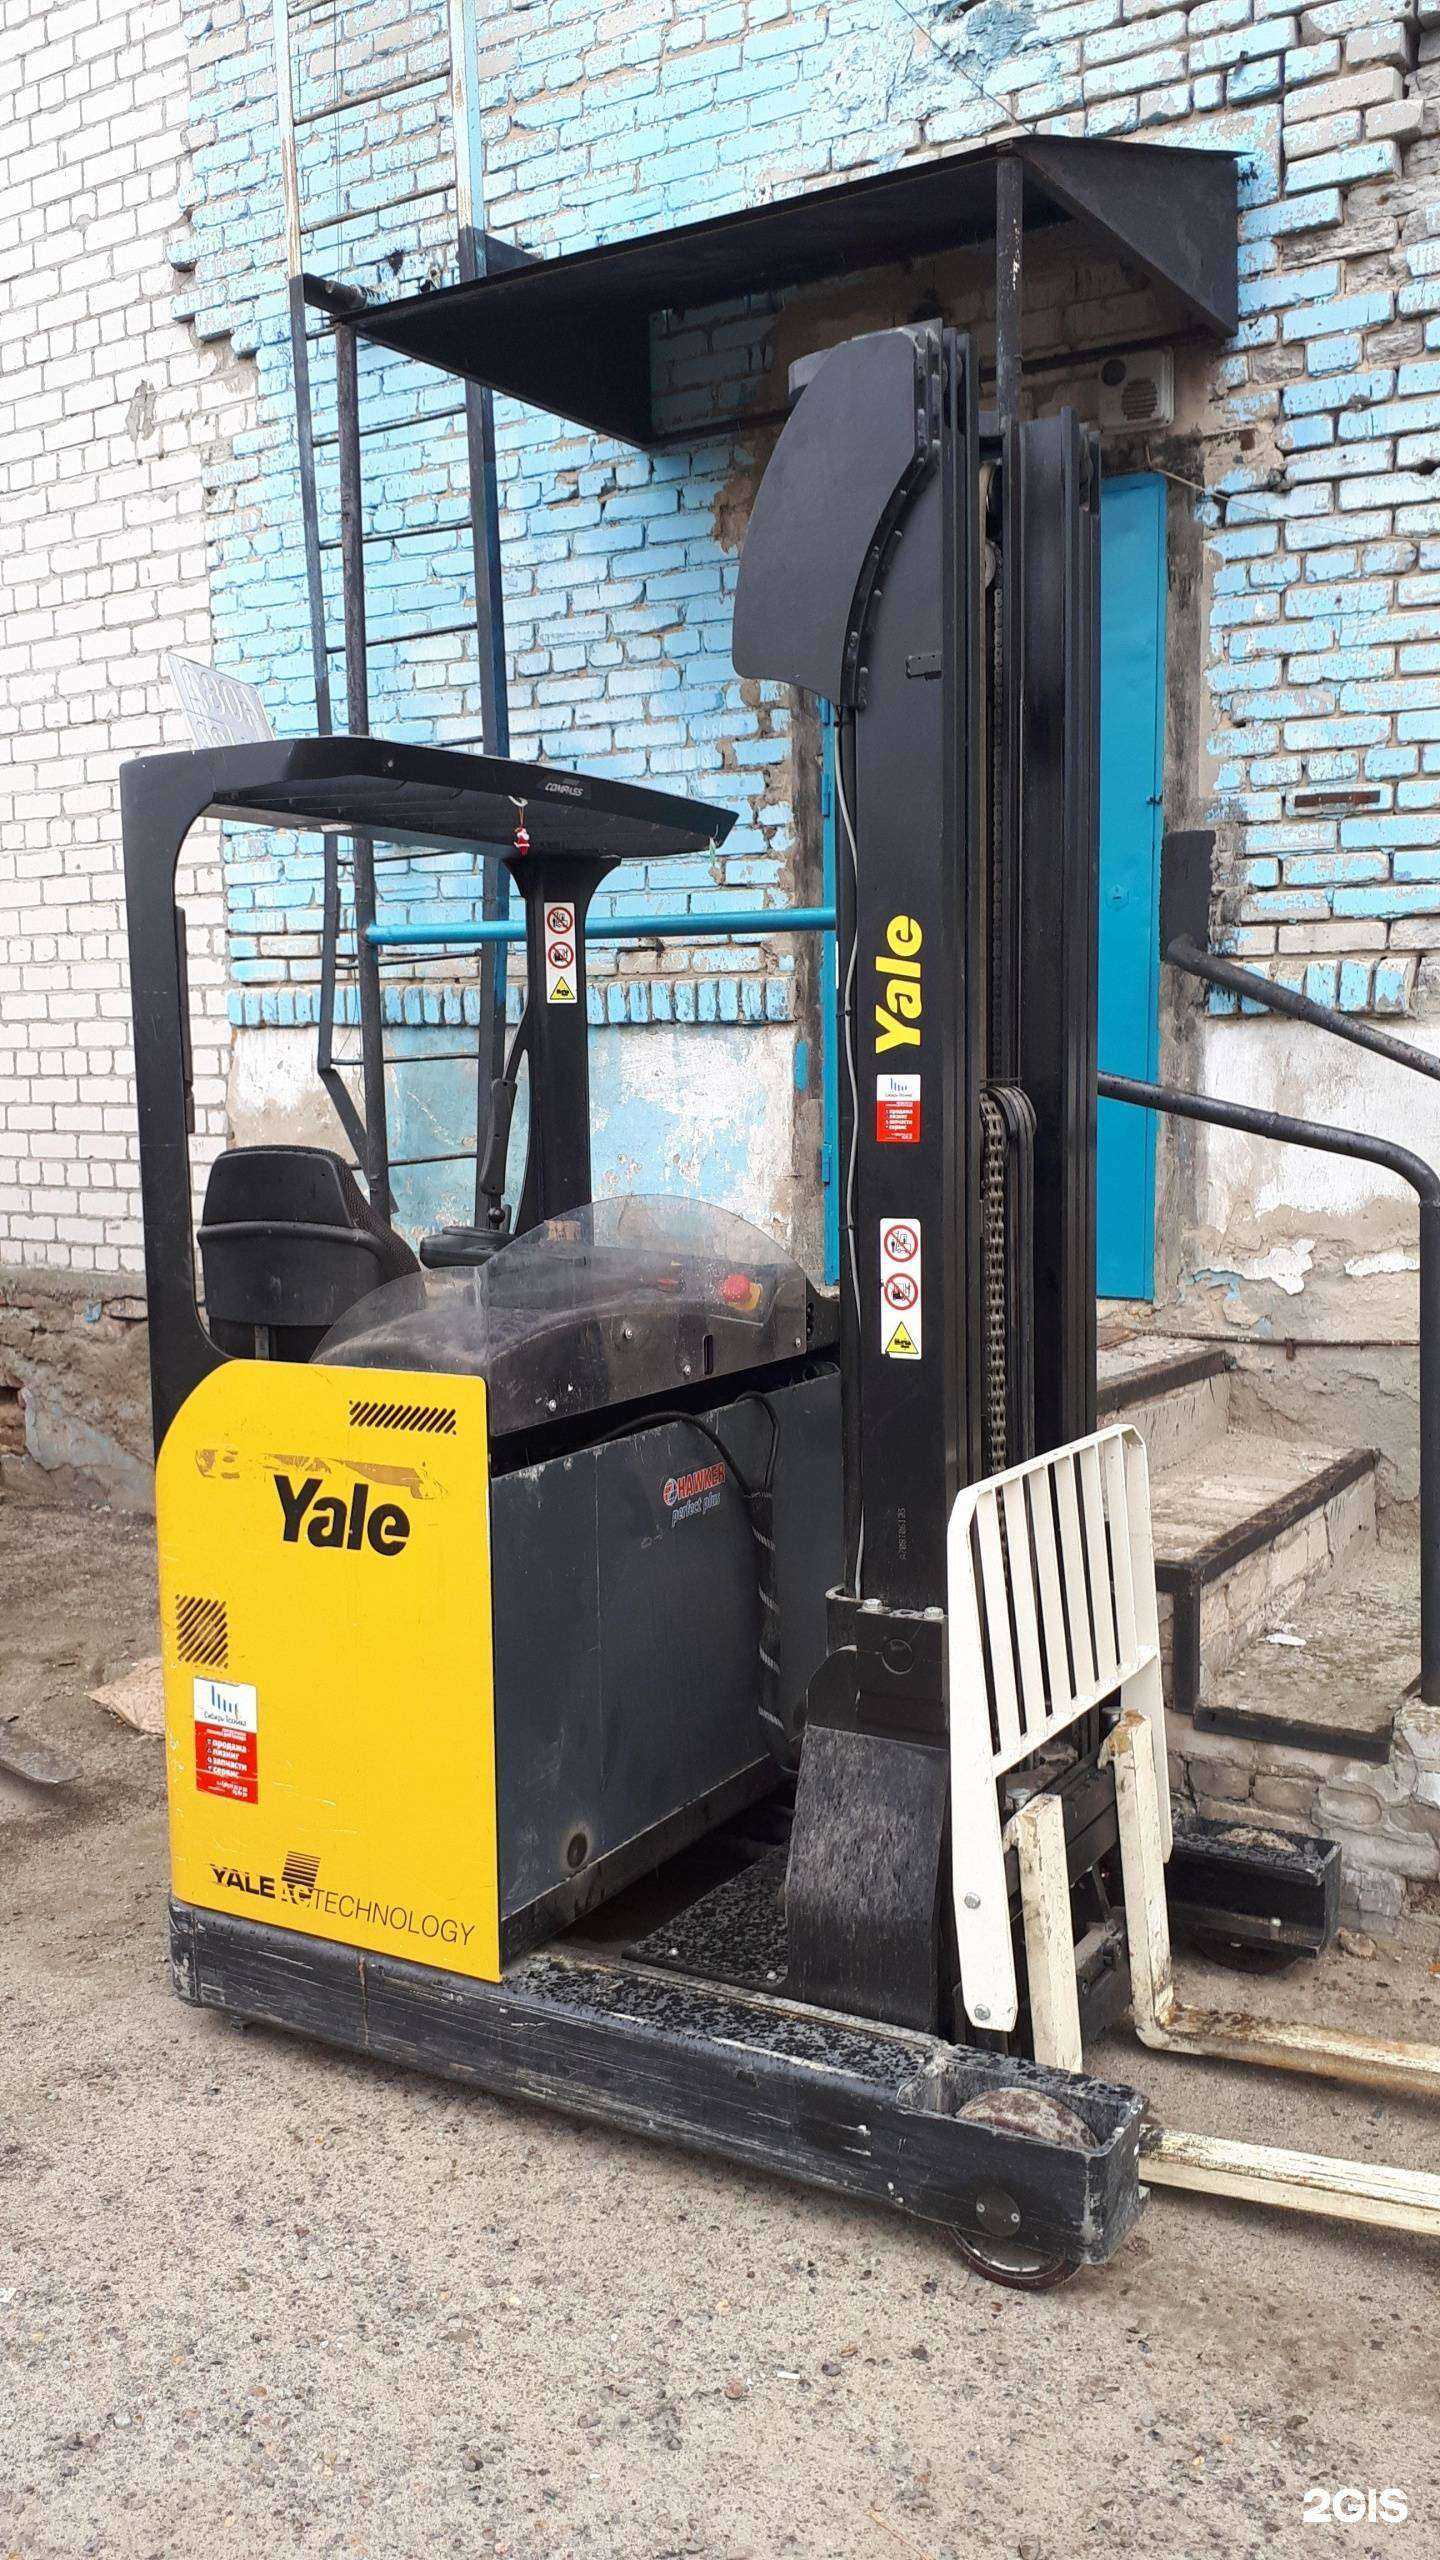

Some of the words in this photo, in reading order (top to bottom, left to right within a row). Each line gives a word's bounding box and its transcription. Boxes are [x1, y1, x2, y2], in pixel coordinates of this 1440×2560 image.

[875, 914, 923, 1054] Yale
[274, 1474, 411, 1557] Yale
[676, 1461, 727, 1501] HAWKER
[210, 1864, 276, 1899] YALE
[312, 1887, 476, 1946] TECHNOLOGY
